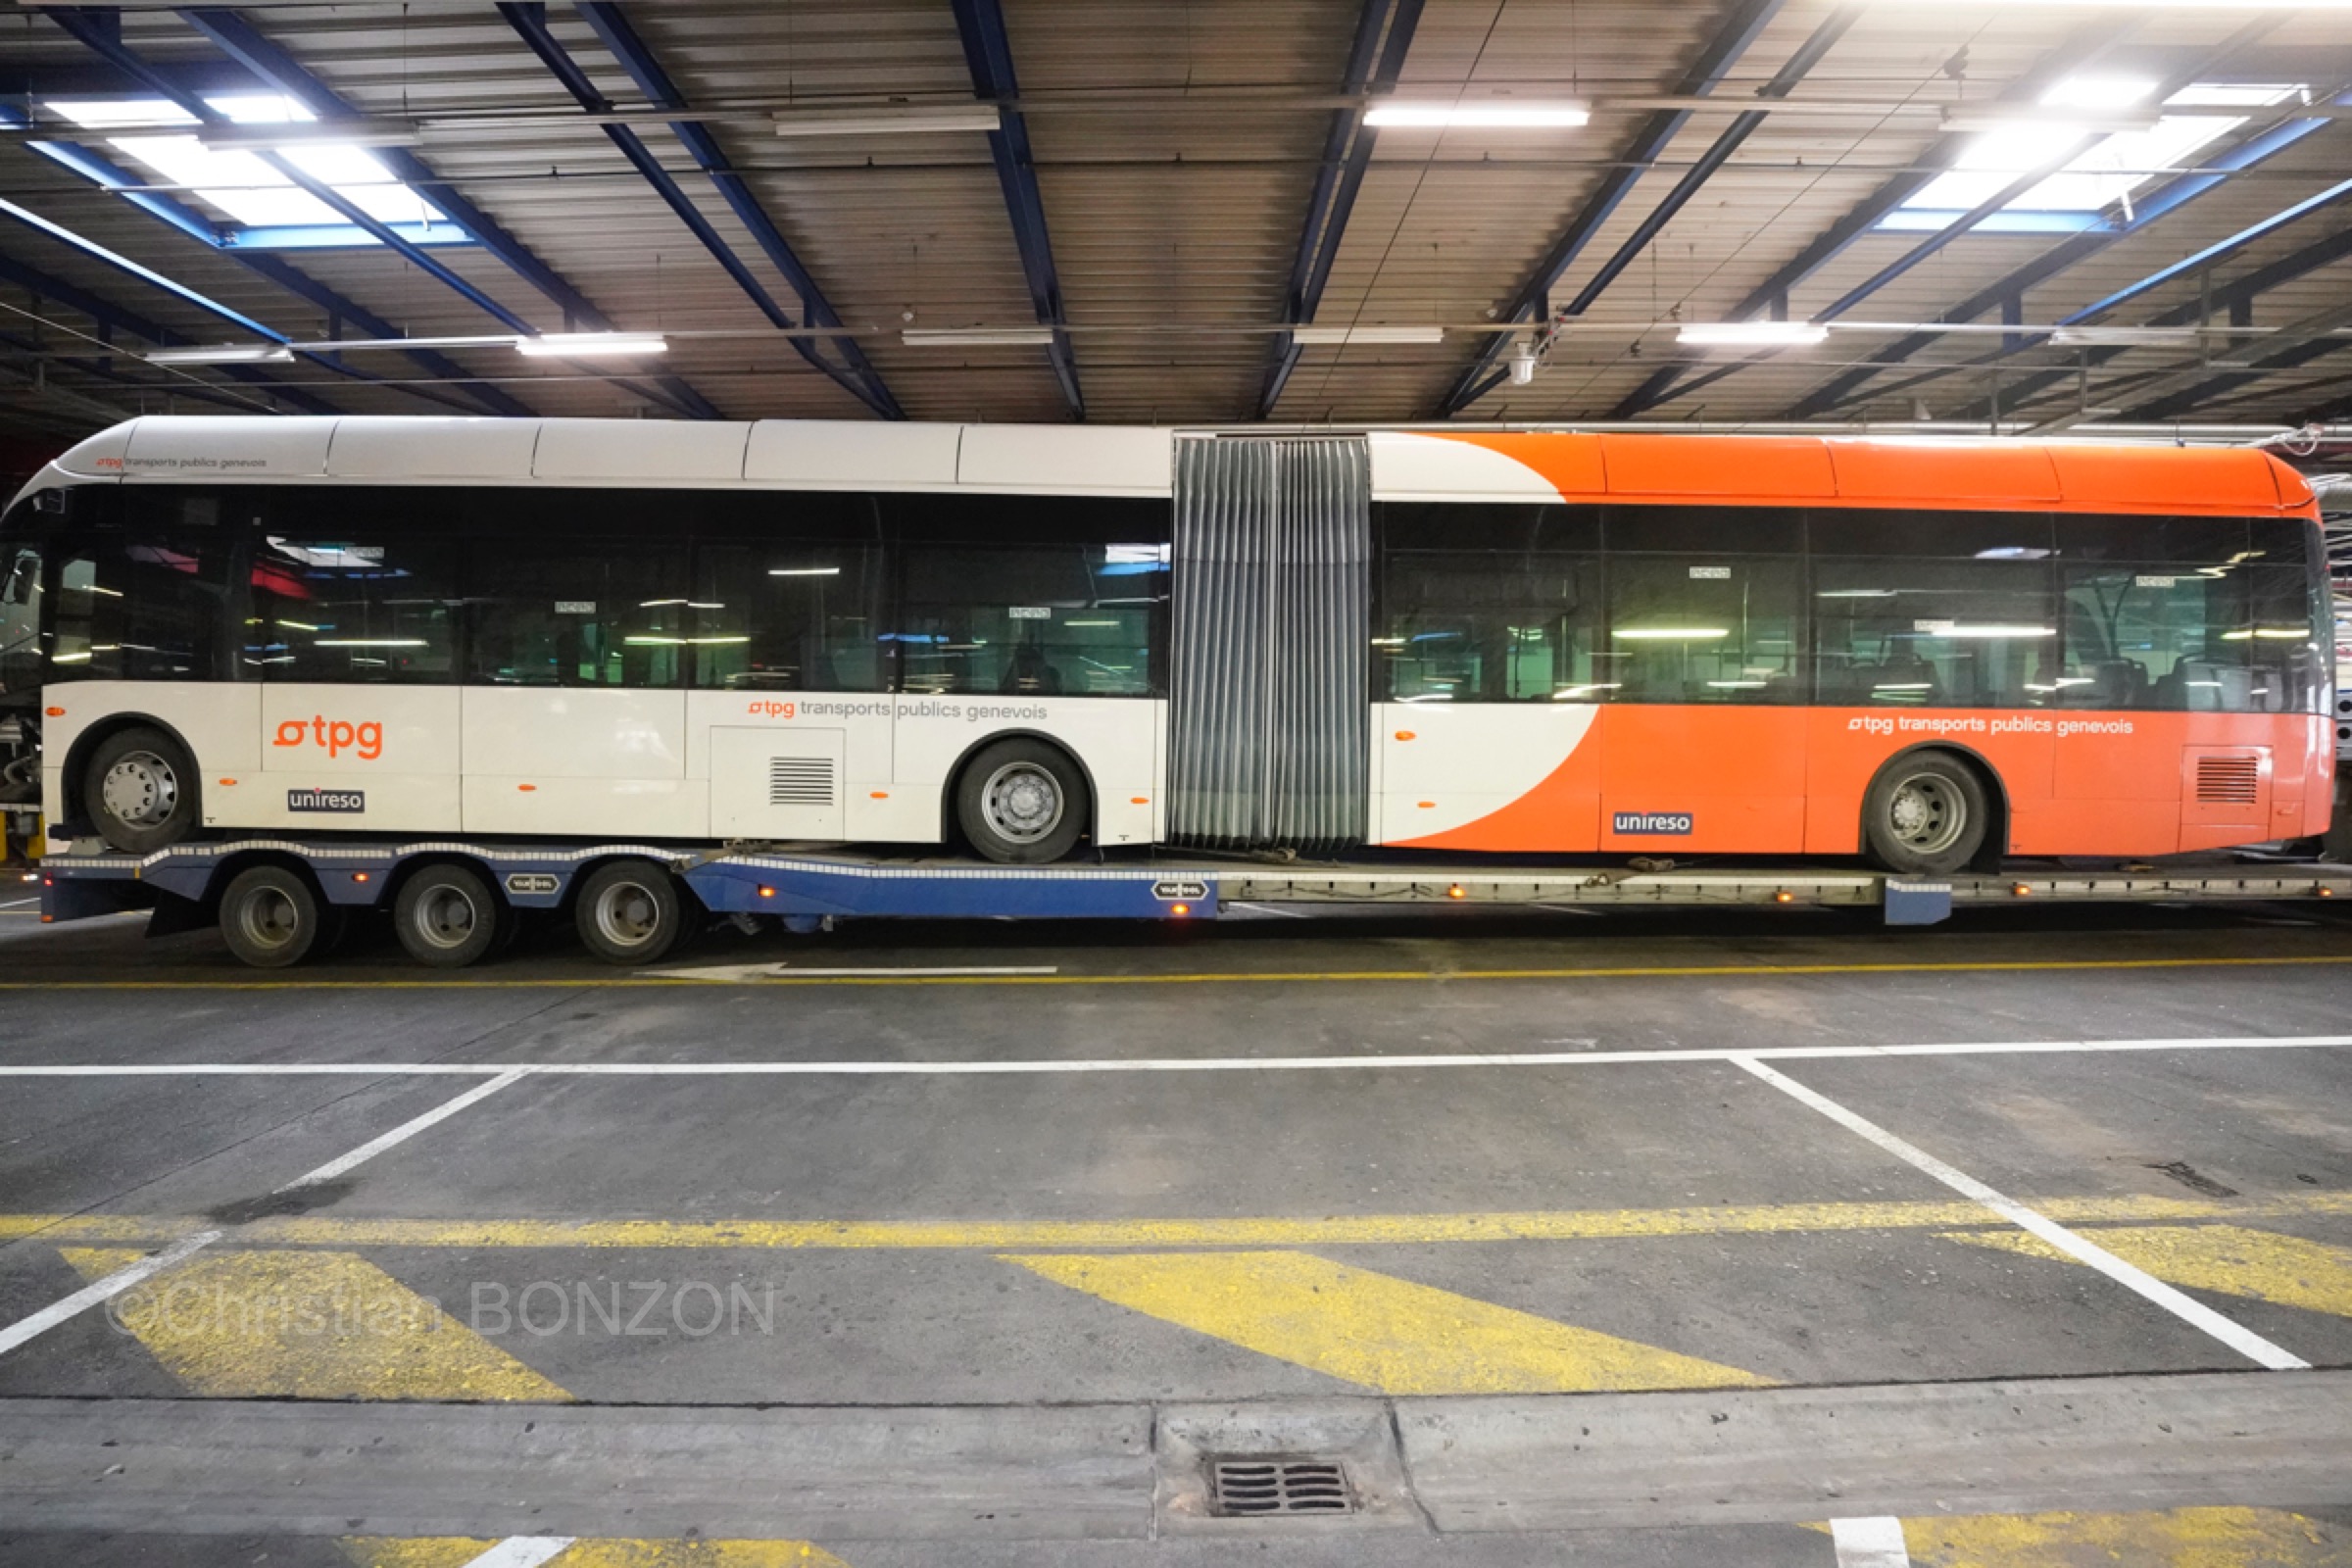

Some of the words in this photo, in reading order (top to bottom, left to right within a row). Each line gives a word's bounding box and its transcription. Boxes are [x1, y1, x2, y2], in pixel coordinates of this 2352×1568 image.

[125, 458, 177, 467] transports
[180, 457, 218, 468] publics
[220, 459, 267, 469] genevois
[800, 701, 891, 719] transports
[898, 701, 961, 719] publics
[966, 704, 1048, 722] genevois
[1898, 715, 1986, 735] transports
[1990, 715, 2053, 735] publics
[2057, 718, 2133, 737] genevois
[289, 787, 363, 808] unireso
[1615, 811, 1690, 830] unireso
